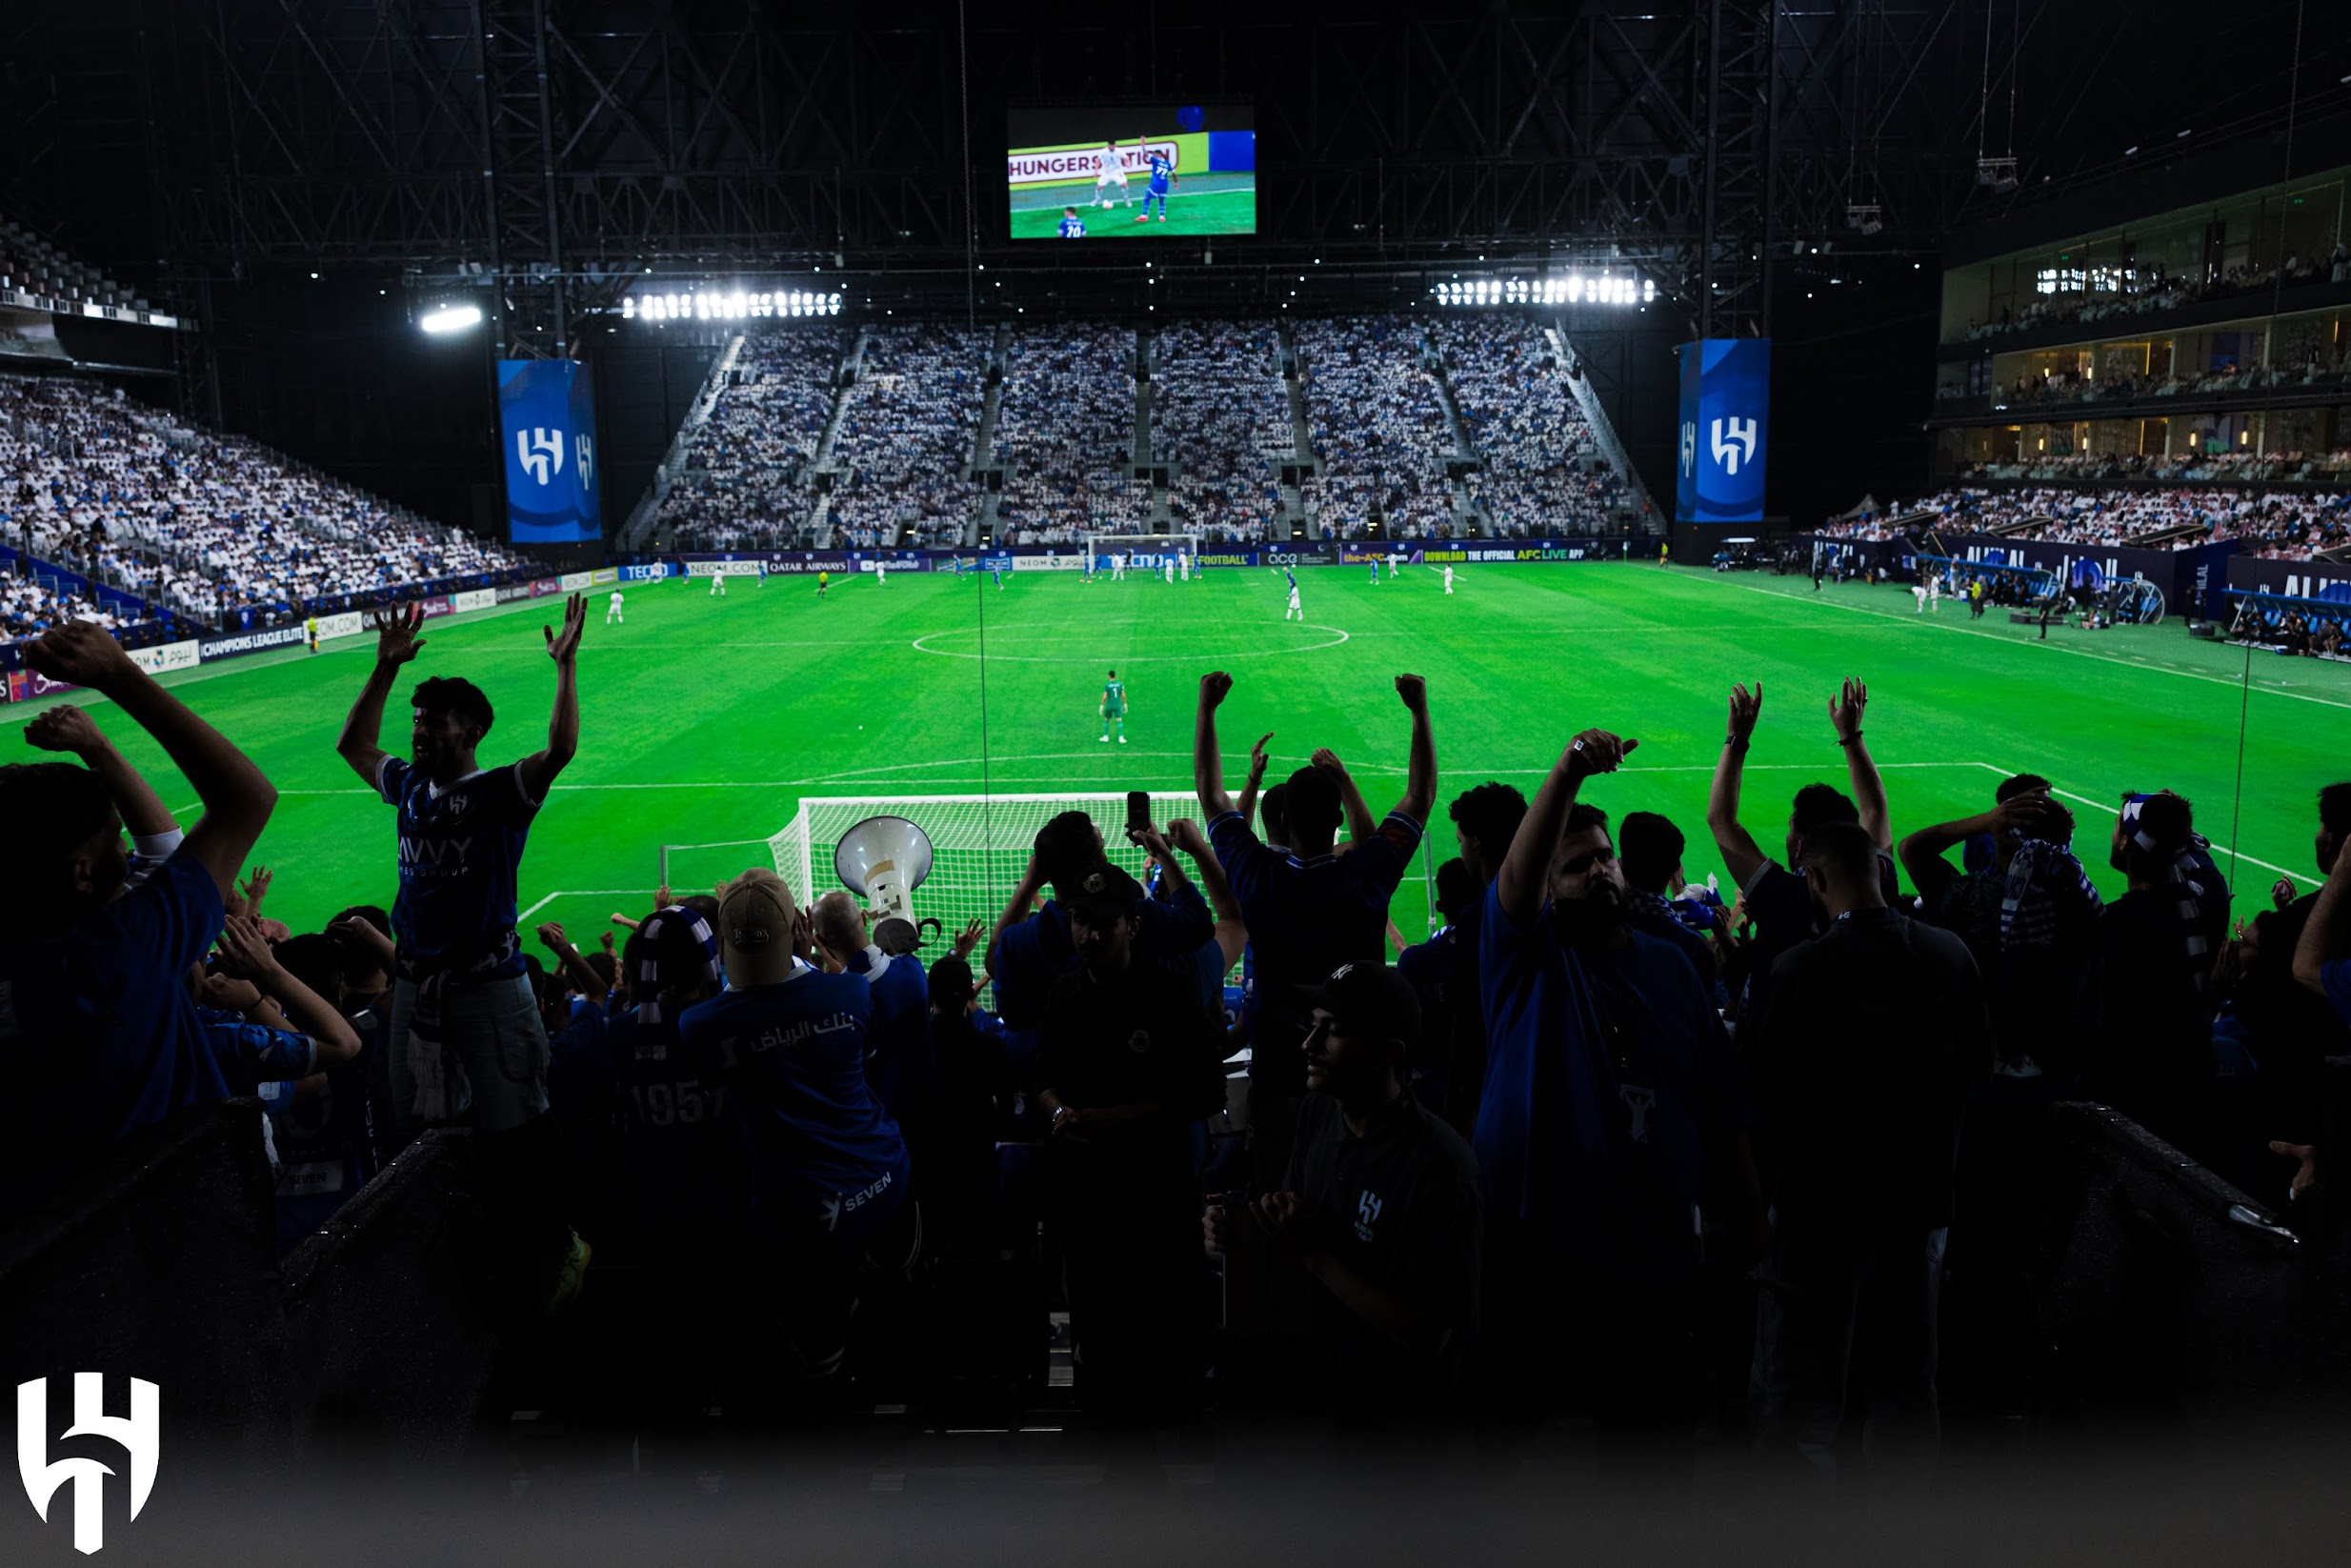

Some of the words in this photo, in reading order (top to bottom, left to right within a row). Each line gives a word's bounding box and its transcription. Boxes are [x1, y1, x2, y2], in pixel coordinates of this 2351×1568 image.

[1009, 148, 1171, 176] HUNGERSTION
[1268, 553, 1298, 564] ace
[1424, 551, 1466, 562] DOWNLOAD
[1468, 550, 1482, 561] THE
[1482, 550, 1517, 561] OFFICIAL
[1517, 549, 1541, 560] AFC
[1541, 549, 1568, 560] LIVE
[1568, 549, 1584, 560] APP
[626, 564, 669, 579] TECO
[770, 562, 803, 573] QATAR
[806, 561, 847, 572] AIRWAYS
[316, 617, 358, 637] EOM.COM
[203, 636, 252, 657] CHAMPIONS
[252, 631, 281, 648] LEAGUE
[282, 626, 303, 641] ELITE
[398, 835, 473, 864] AVVY
[289, 1173, 327, 1186] SEVEN
[844, 1170, 893, 1212] SEVEN
